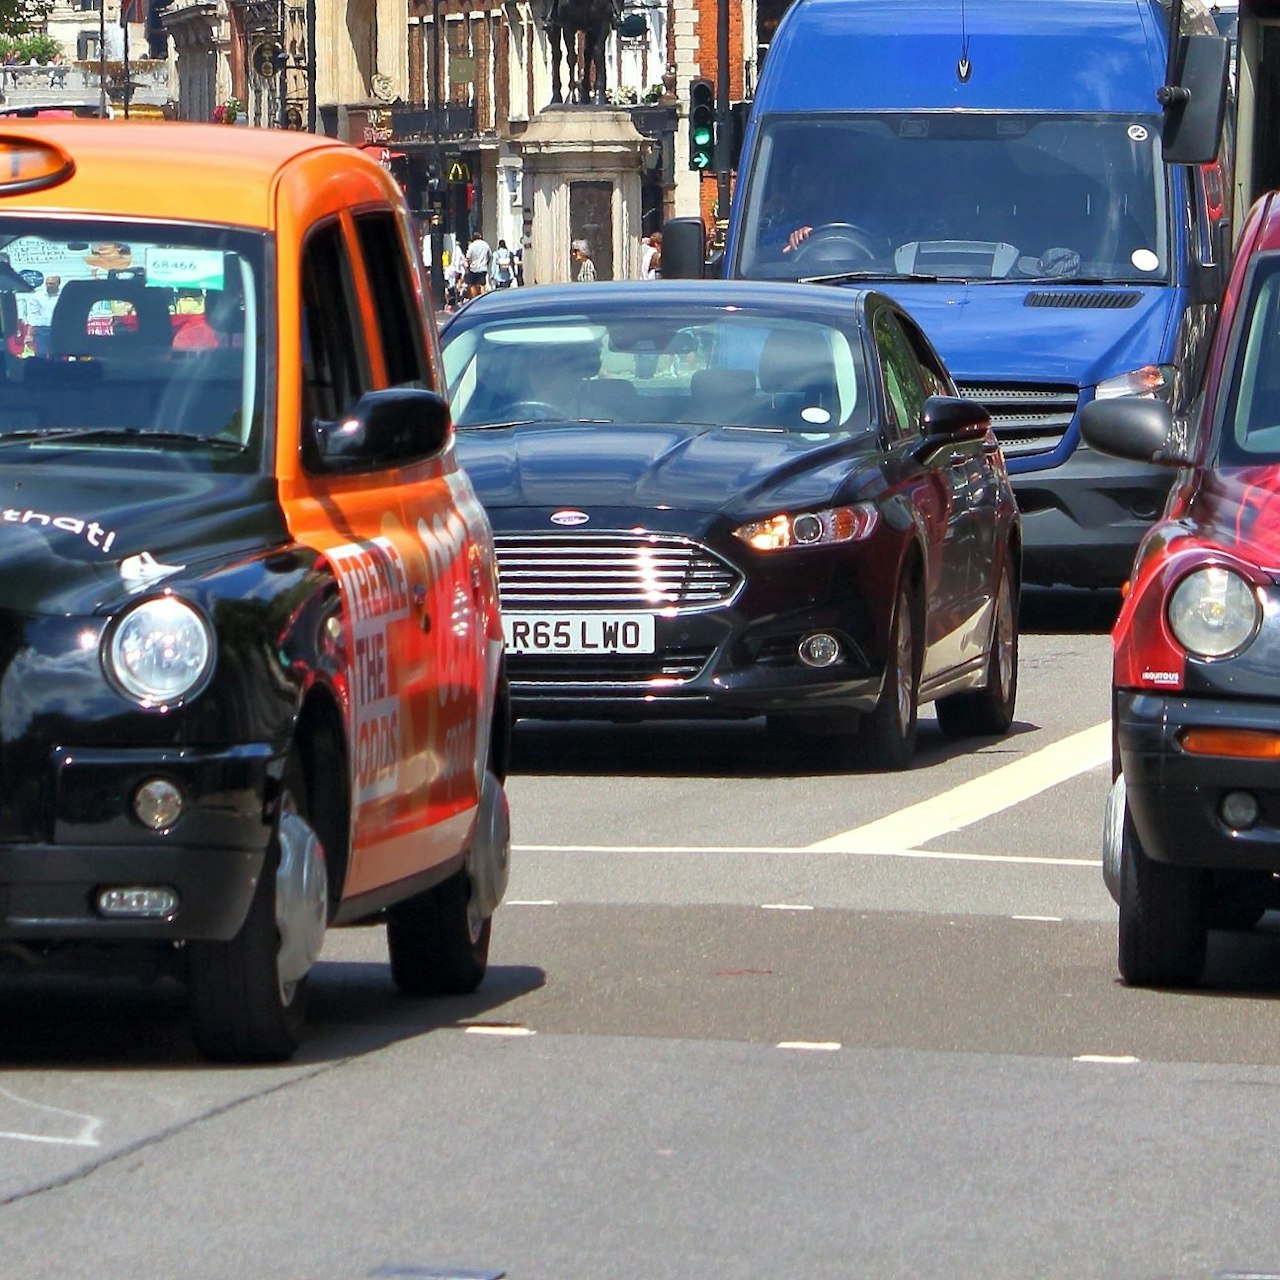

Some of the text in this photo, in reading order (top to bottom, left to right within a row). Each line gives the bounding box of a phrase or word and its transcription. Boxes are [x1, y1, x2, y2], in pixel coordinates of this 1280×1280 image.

[2, 508, 117, 554] that!
[505, 620, 640, 649] R65 LWO
[355, 632, 388, 705] THE
[357, 709, 399, 790] ODDS
